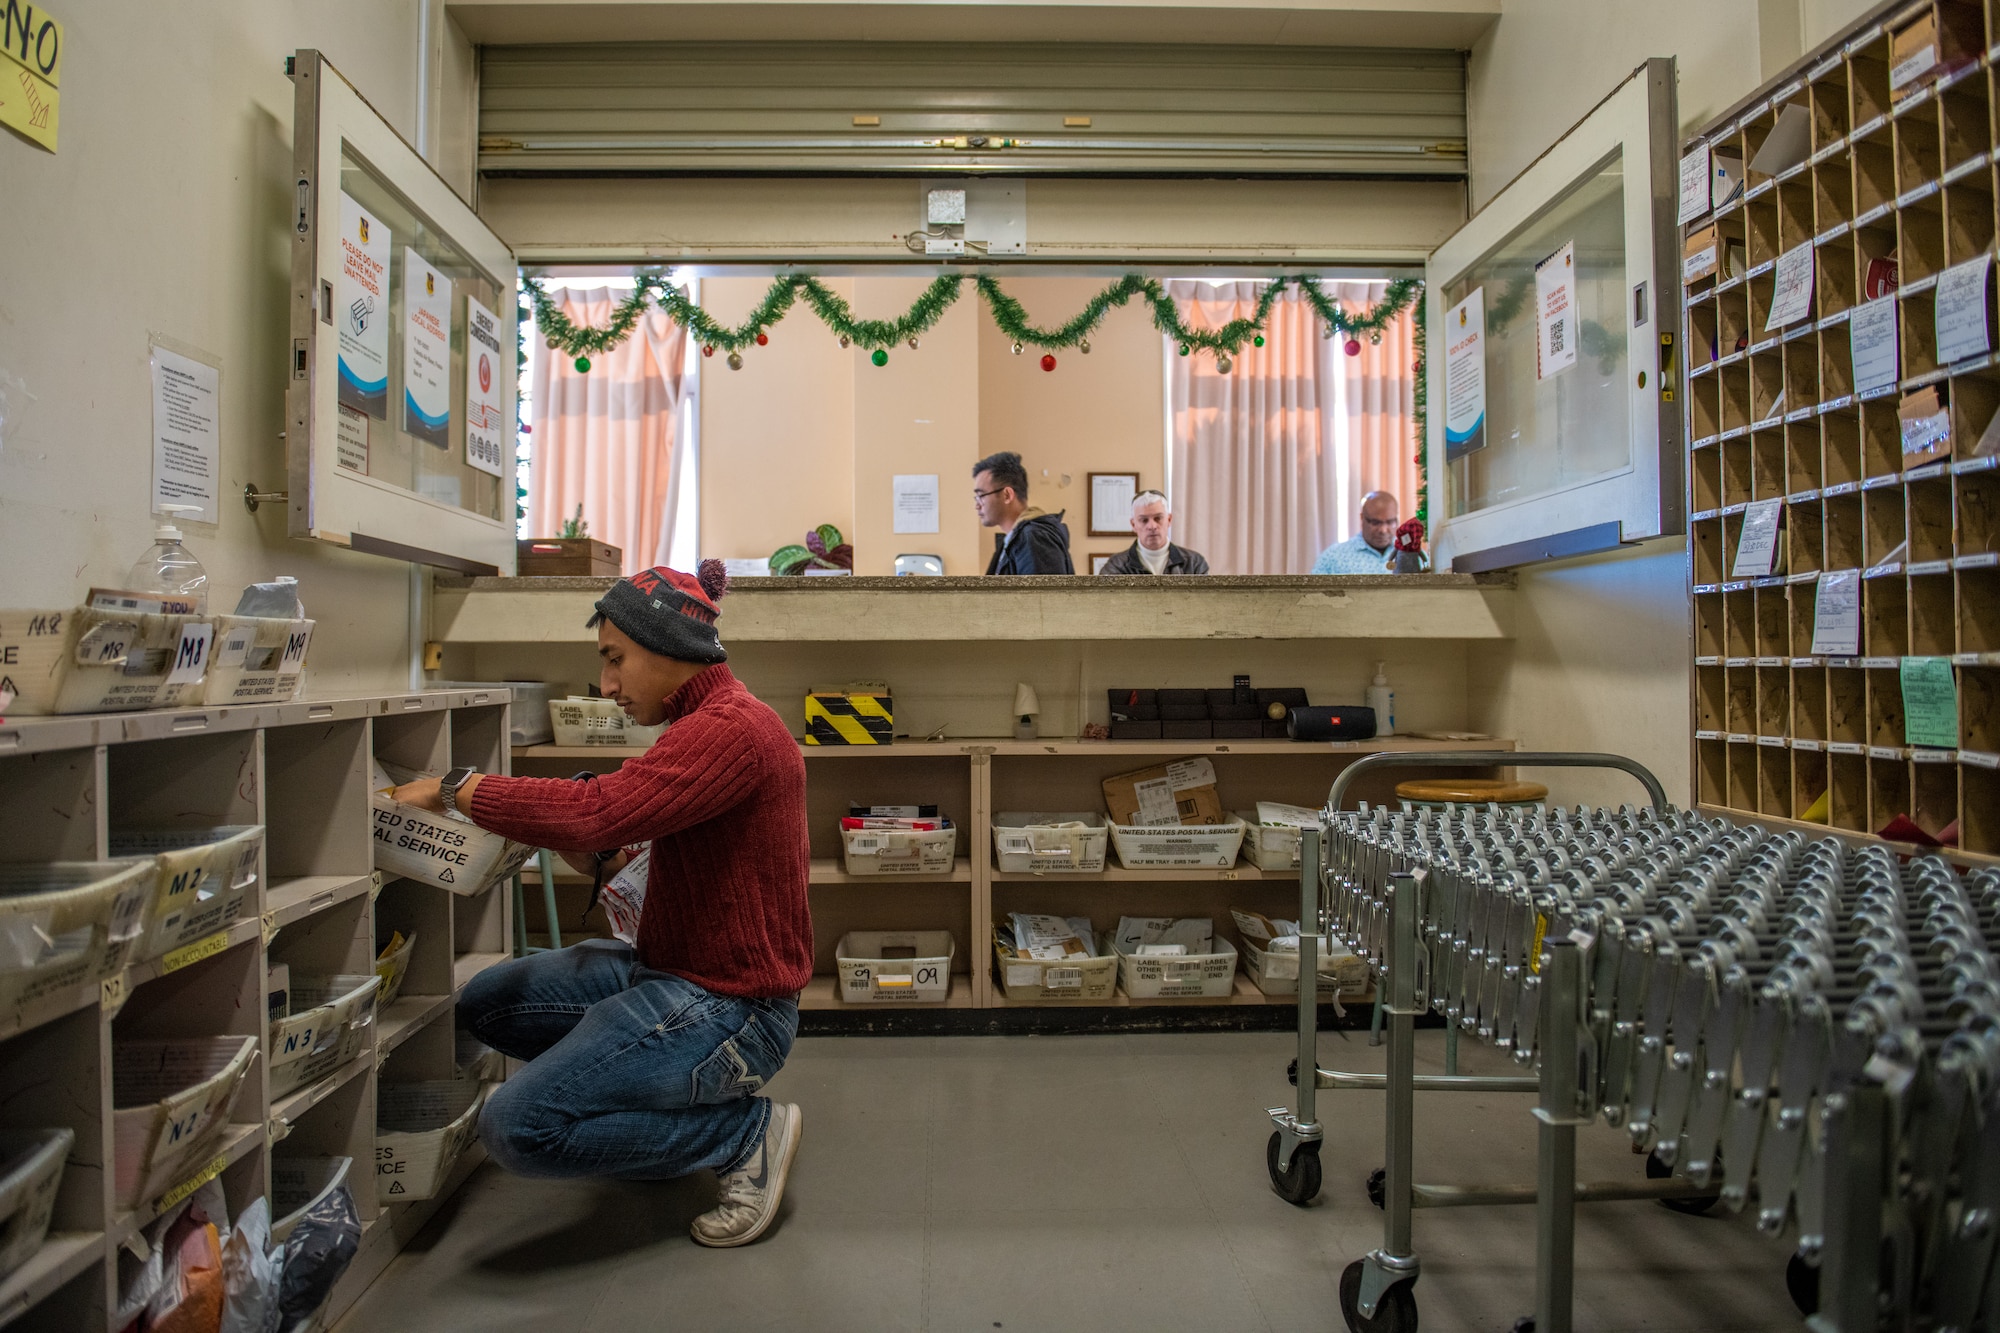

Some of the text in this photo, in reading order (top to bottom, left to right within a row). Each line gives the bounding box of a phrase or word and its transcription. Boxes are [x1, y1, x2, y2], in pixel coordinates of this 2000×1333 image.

[342, 237, 384, 276] PLEASE DO NOT
[344, 264, 380, 296] UNATTENDED.
[346, 253, 377, 284] LEAVE MAIL
[412, 312, 446, 342] LOCAL ADDRESS
[418, 306, 440, 328] JAPANESE
[476, 310, 494, 334] ENERGY
[470, 320, 500, 355] CONSERVATION
[1465, 331, 1478, 348] CHECK
[170, 602, 188, 614] YOU
[98, 641, 124, 661] M8
[177, 636, 204, 670] M8
[284, 632, 306, 662] M9
[108, 686, 159, 694] UNITED STATES
[232, 688, 275, 696] POSTAL SERVICE
[239, 678, 276, 687] UNITED STATES
[100, 696, 156, 705] POSTAL SERVICE
[404, 819, 468, 847] STATES
[397, 835, 469, 866] SERVICE
[855, 968, 870, 980] 09
[917, 967, 938, 985] 09
